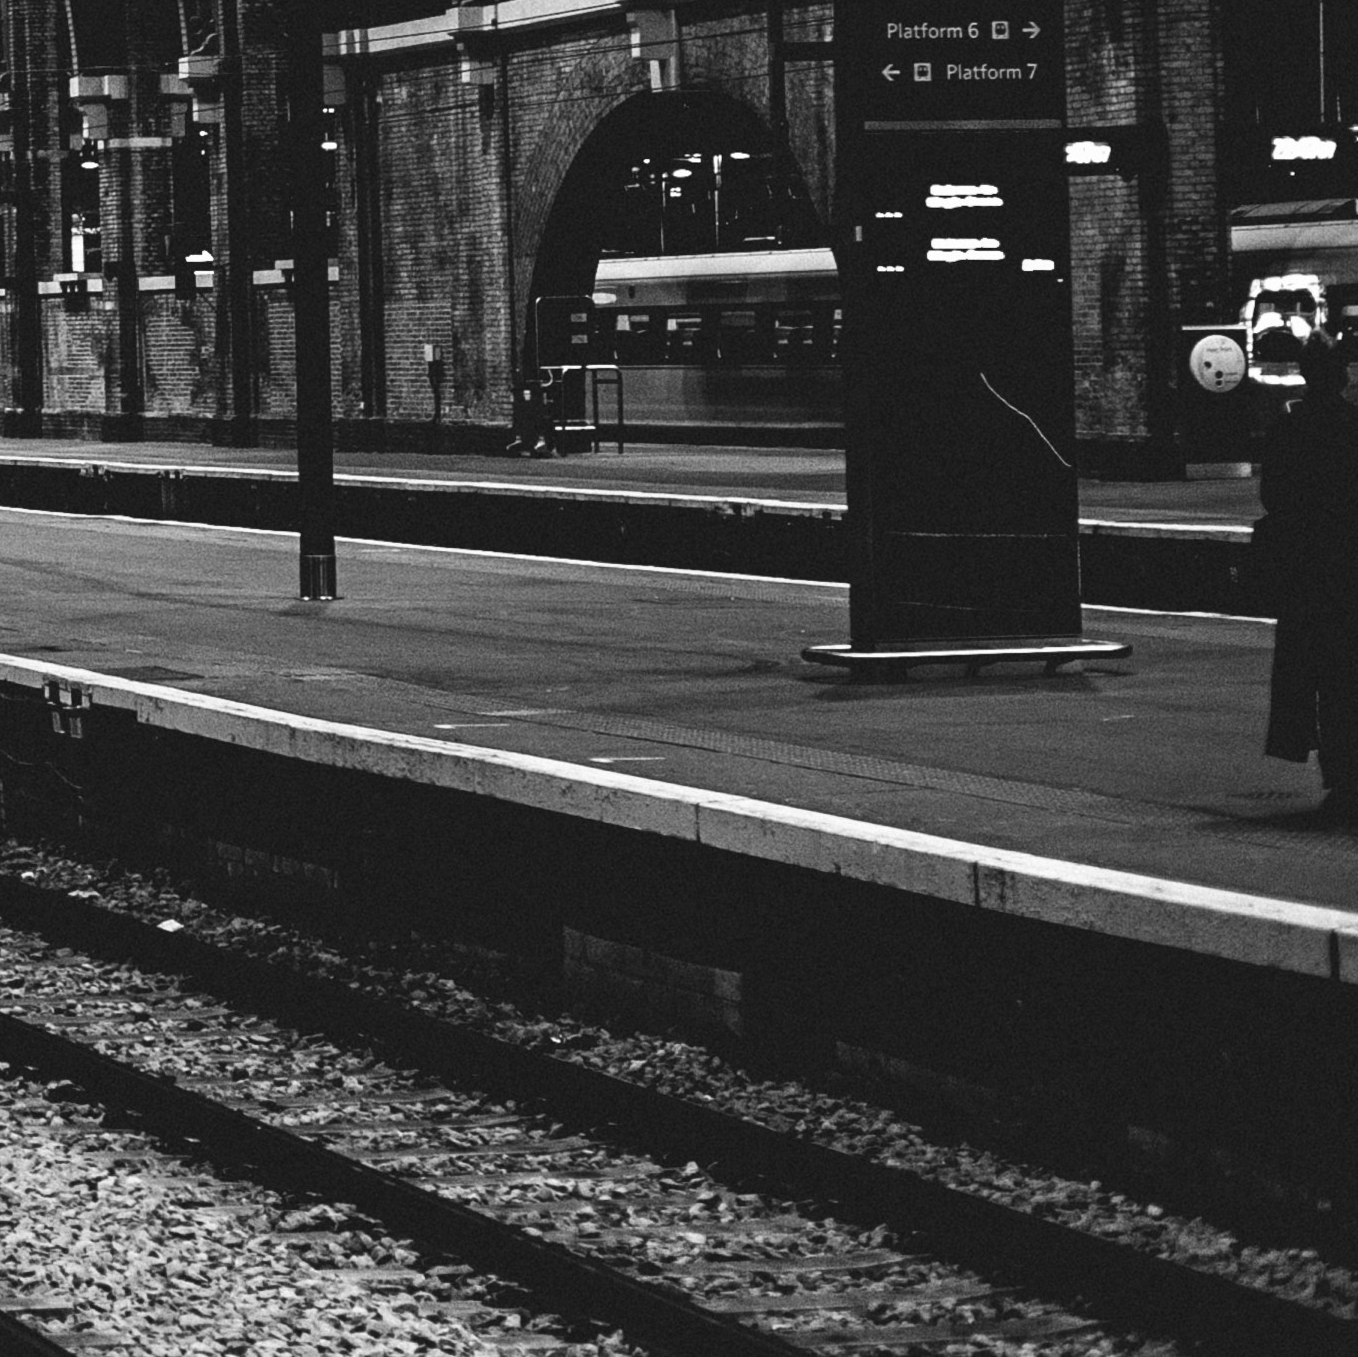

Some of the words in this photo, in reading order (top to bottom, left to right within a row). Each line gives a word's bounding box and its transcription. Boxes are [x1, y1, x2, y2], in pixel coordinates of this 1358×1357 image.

[887, 22, 963, 40] Platform
[967, 21, 980, 39] 6
[946, 63, 1022, 81] Platform
[1026, 62, 1038, 80] 7
